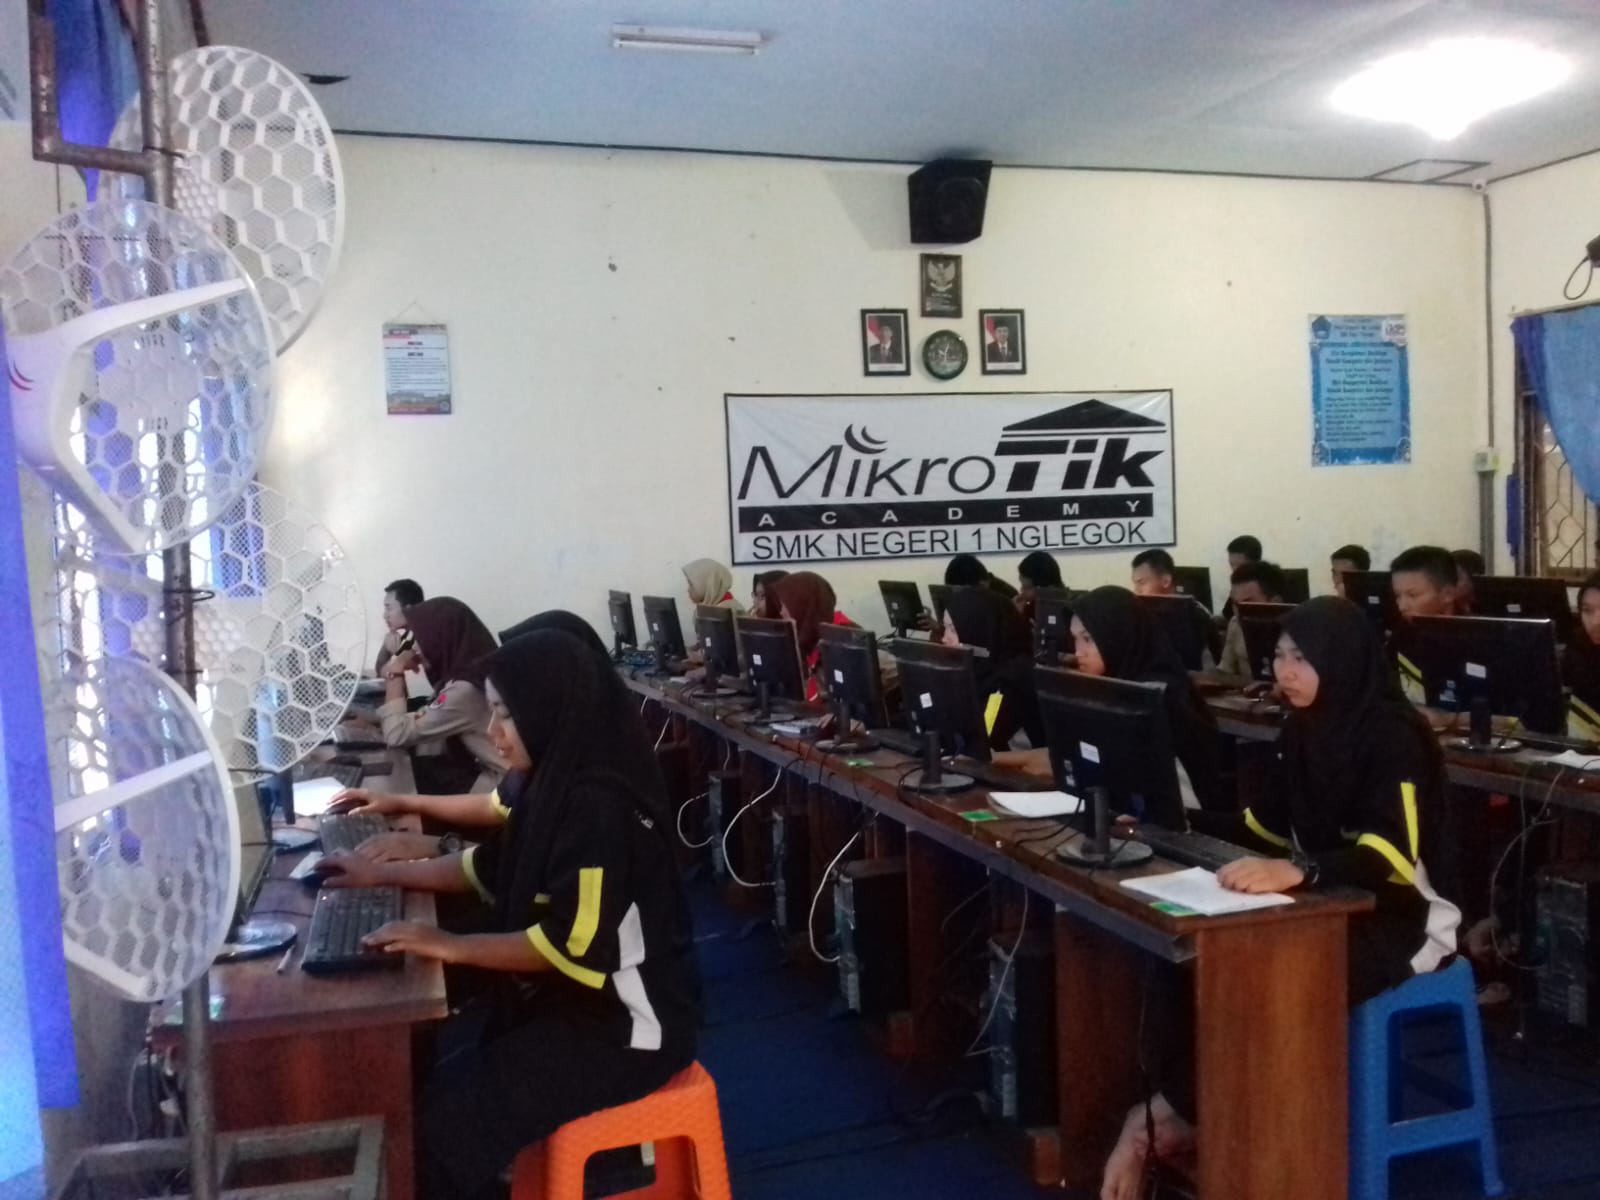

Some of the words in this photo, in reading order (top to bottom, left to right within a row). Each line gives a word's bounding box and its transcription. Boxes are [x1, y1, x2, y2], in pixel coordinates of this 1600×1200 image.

[737, 424, 1165, 500] MikroTik
[757, 499, 1141, 527] ACADEMY
[751, 533, 826, 561] SMK
[836, 528, 959, 557] NEGERI
[971, 527, 983, 552] 1
[996, 520, 1148, 551] NGLEGOK
